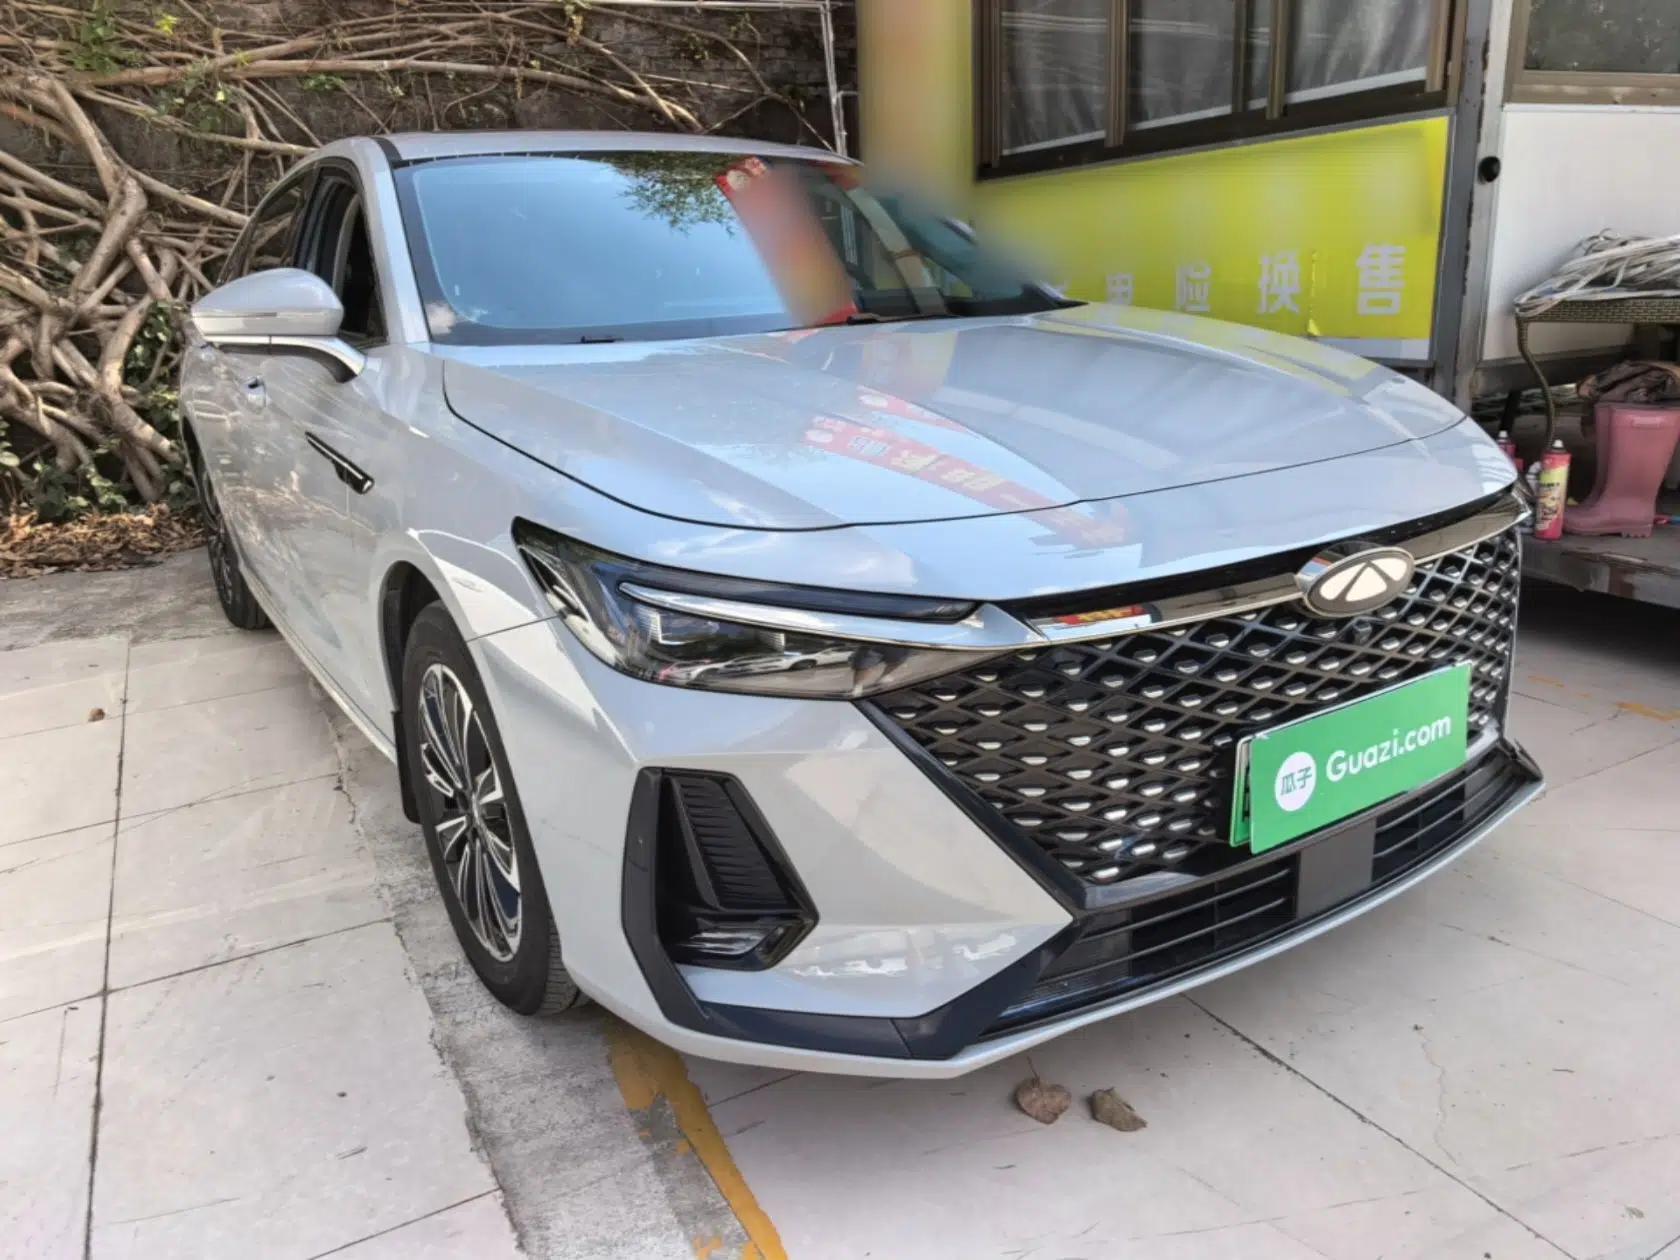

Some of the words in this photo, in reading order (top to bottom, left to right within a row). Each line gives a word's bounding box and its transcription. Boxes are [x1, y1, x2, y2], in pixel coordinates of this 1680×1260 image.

[1257, 252, 1300, 315] 换
[1356, 243, 1406, 316] 售
[1280, 766, 1312, 796] 瓜子
[1326, 715, 1451, 782] Guazi.com
